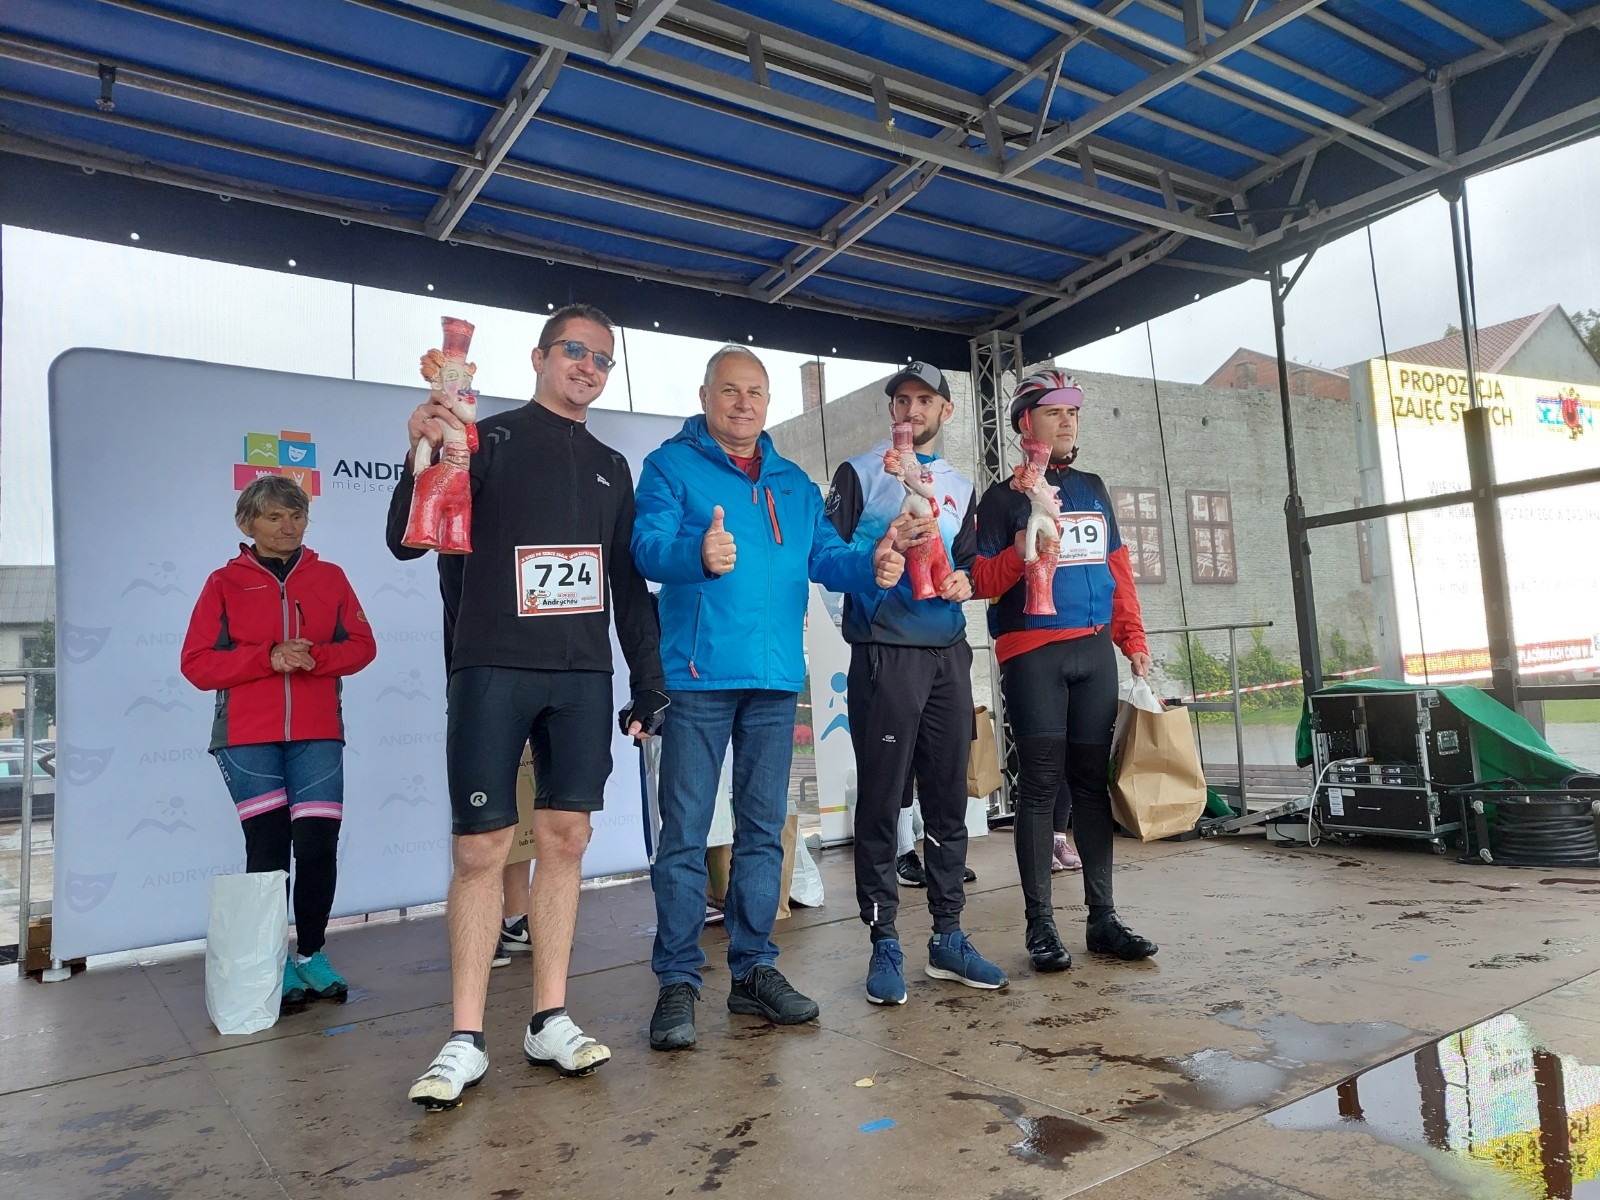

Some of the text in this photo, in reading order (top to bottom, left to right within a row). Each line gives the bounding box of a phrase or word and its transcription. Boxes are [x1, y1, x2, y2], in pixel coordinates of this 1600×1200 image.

[1400, 368, 1505, 399] PROPOZCJA
[332, 480, 394, 494] miejsce
[534, 562, 592, 588] 724
[377, 630, 444, 642] ANDRYC
[379, 731, 447, 746] ANDRYC
[139, 747, 209, 765] ANDRY
